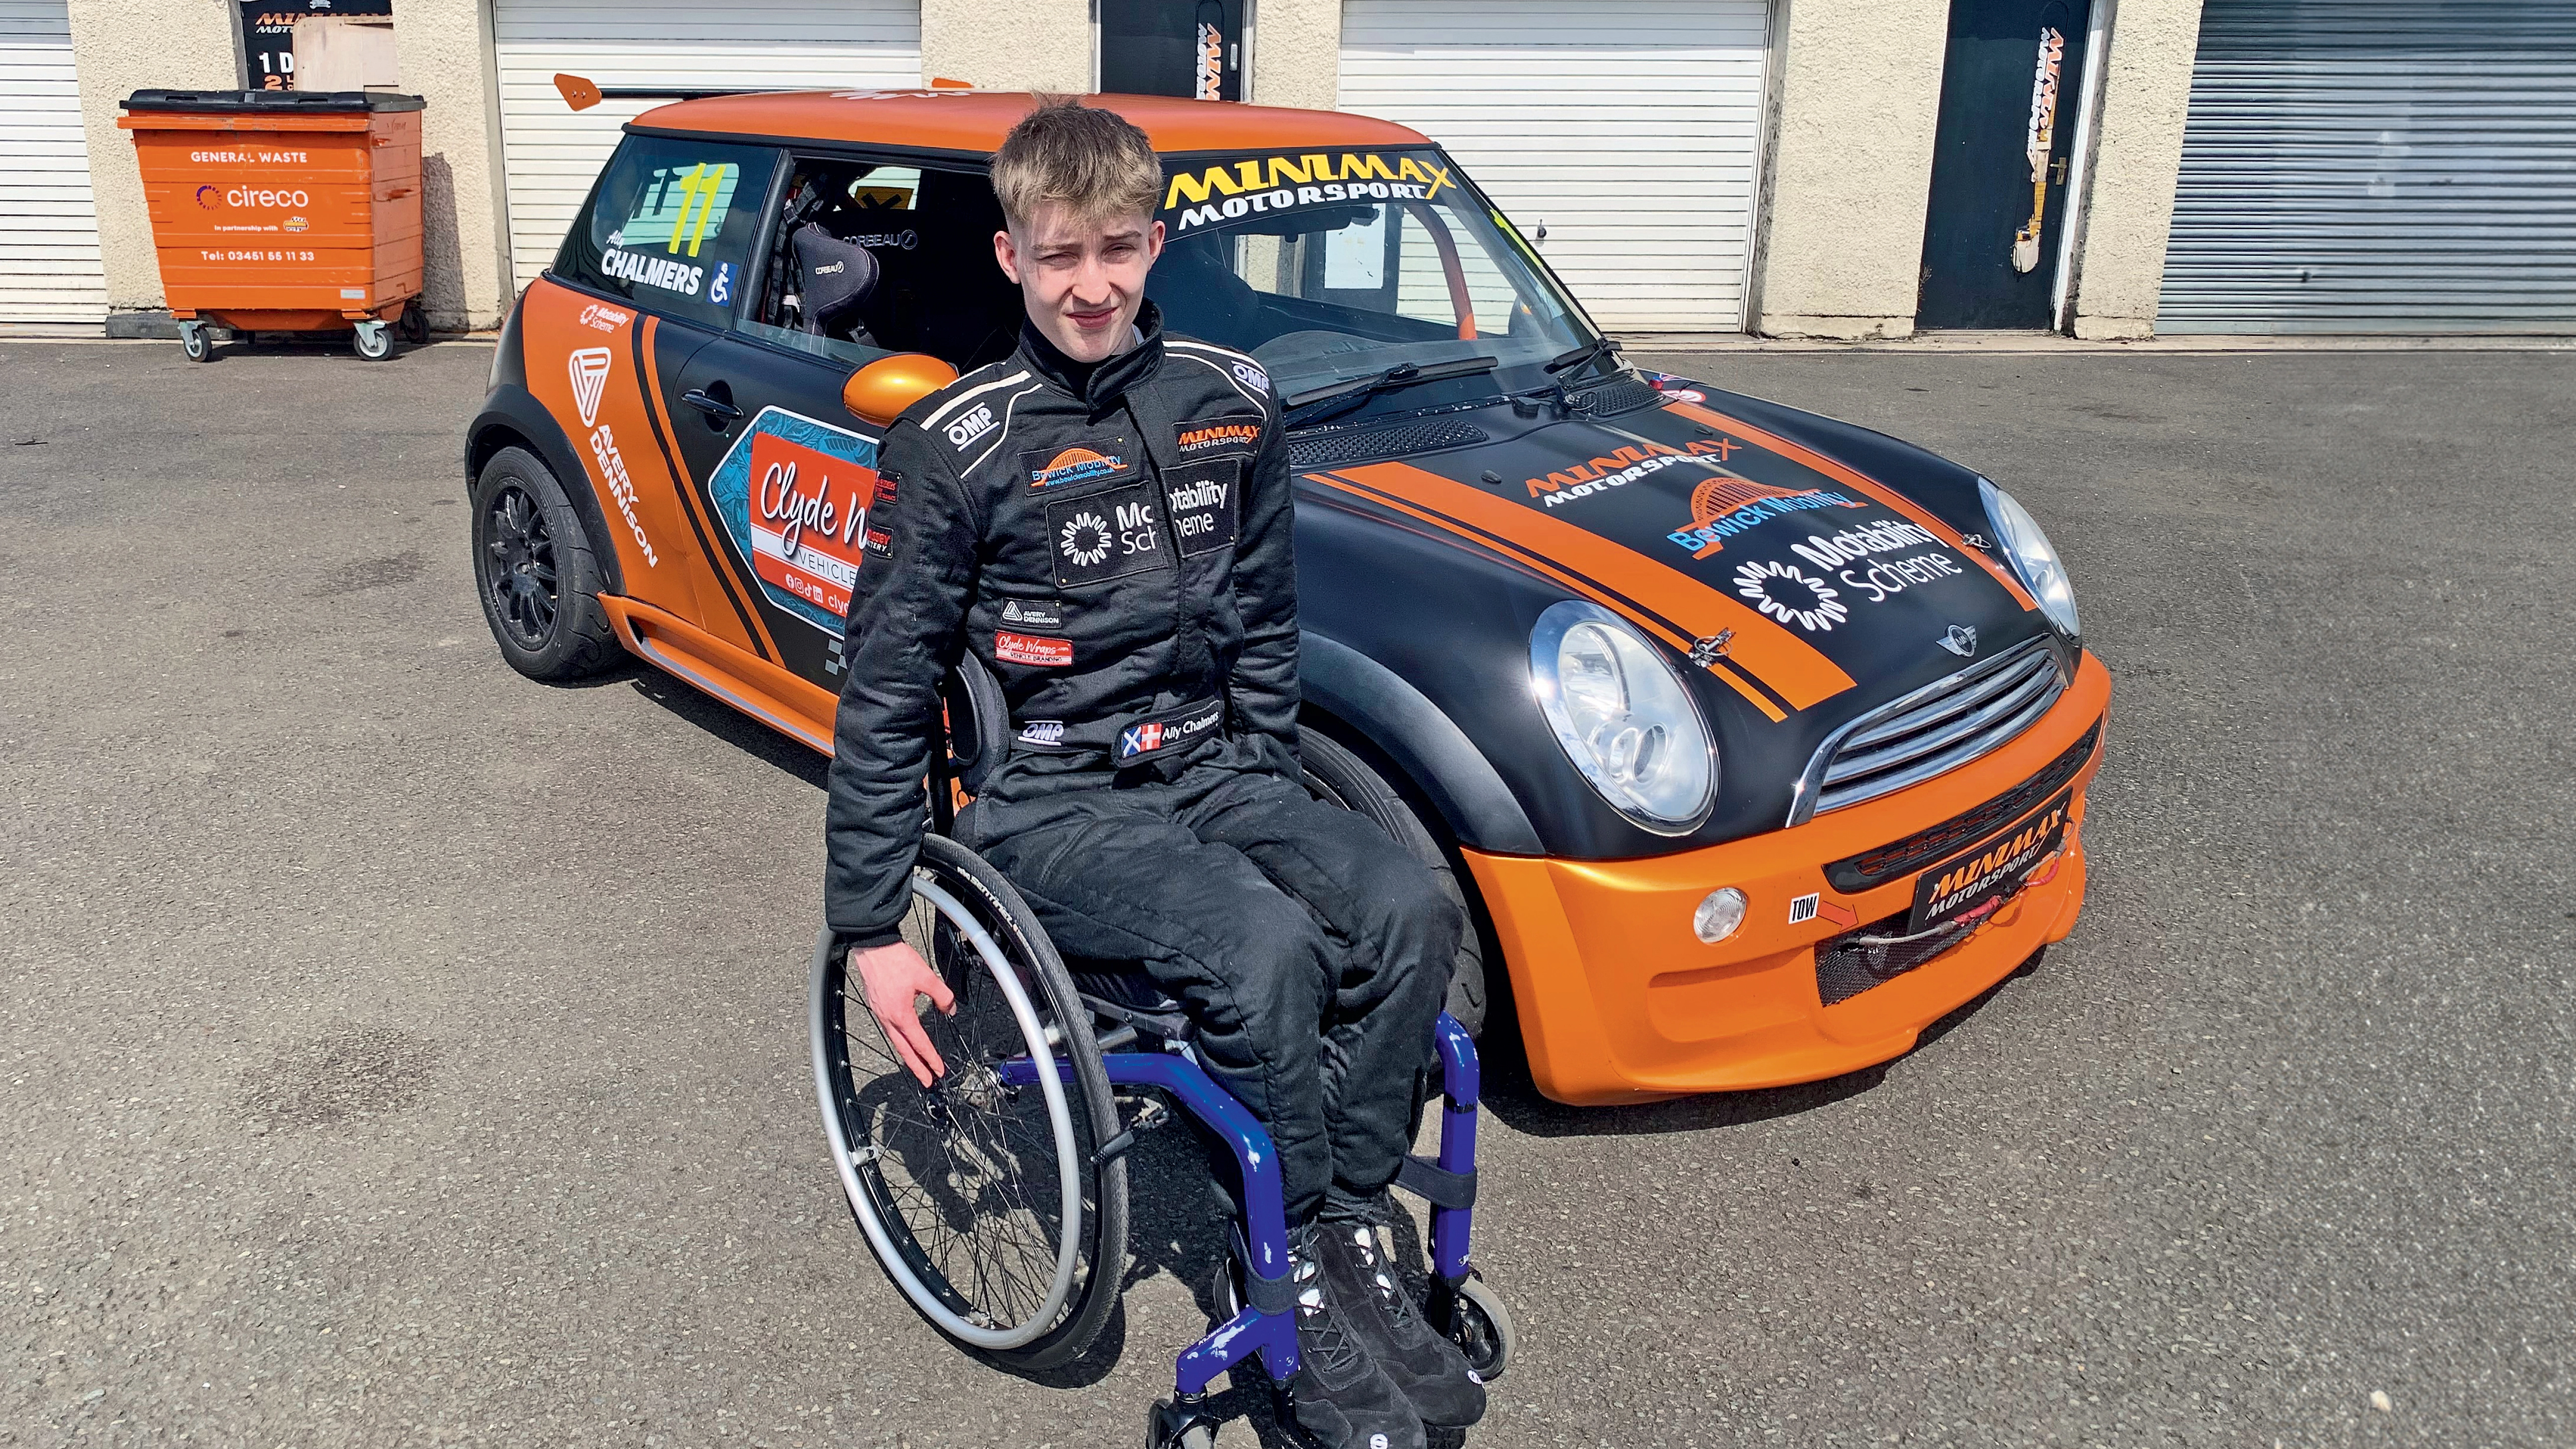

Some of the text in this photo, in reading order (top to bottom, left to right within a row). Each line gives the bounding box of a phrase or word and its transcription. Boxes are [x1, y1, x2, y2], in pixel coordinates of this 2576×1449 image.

[259, 52, 271, 73] 1
[191, 152, 307, 163] GENERAL WASTE
[227, 185, 309, 207] cireco
[1164, 154, 1457, 210] MINIMAX
[668, 162, 726, 258] 11
[1178, 183, 1427, 231] MOTORSPORT
[606, 230, 625, 249] Ally
[843, 234, 900, 247] CORBEAU
[201, 251, 224, 260] Tel:
[228, 251, 264, 261] 03451
[286, 252, 296, 261] 11
[300, 252, 315, 261] 33
[601, 249, 703, 296] CHALMERS
[590, 316, 615, 333] Scheme
[596, 307, 629, 327] Motability
[1232, 364, 1269, 390] OMP
[948, 407, 992, 445] OMP
[1179, 425, 1261, 445] MINIMAX
[1179, 437, 1249, 452] MOTORSPORT
[599, 424, 639, 504] AVERY
[1031, 466, 1073, 481] Bewick
[1525, 437, 1743, 499] MINIMAX
[1543, 454, 1721, 508] MOTORSPORT
[589, 430, 658, 568] DENNISON
[760, 461, 839, 555] Clyde
[1666, 490, 1858, 551] Bewick Mobility
[1790, 520, 1950, 572] Motability
[798, 549, 858, 586] VEHICLE
[1840, 552, 1963, 602] Scheme
[999, 636, 1025, 652] Clyde
[1023, 724, 1064, 741] OMP
[1162, 712, 1219, 740] Ally Chalmers
[1928, 801, 2067, 904] MINIMAX
[1925, 842, 2041, 920] MOTORSPORT
[1793, 895, 1818, 923] TOW
